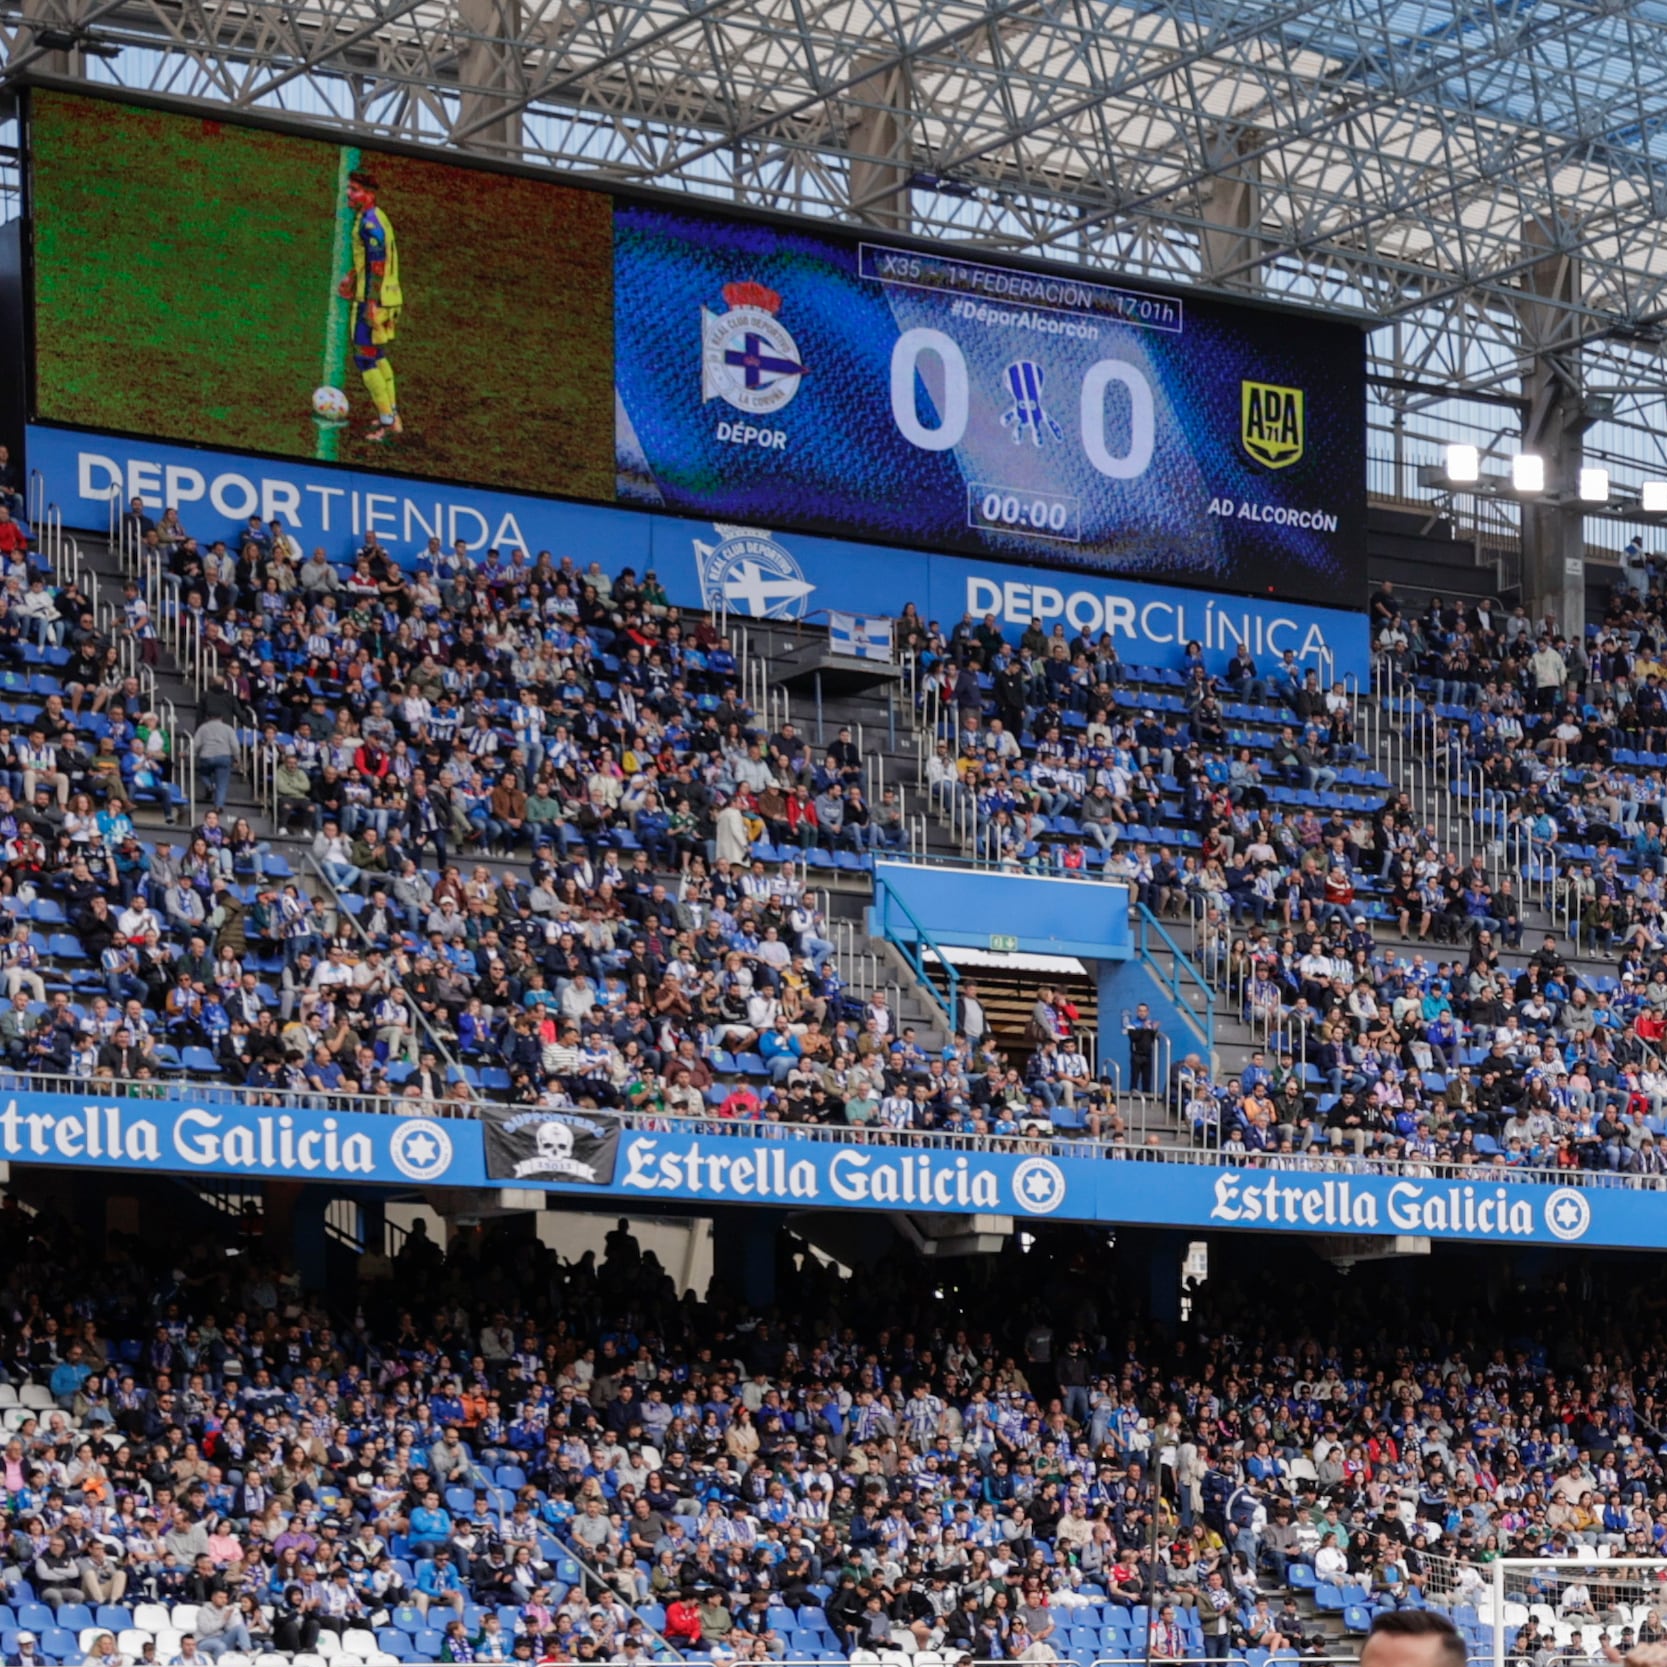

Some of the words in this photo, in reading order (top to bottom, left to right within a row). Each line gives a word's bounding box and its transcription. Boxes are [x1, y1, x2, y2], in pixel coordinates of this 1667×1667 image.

[883, 255, 921, 278] X35
[971, 270, 1092, 310] FEDERACIÓN
[951, 300, 1099, 340] #DéporAlcorcón
[890, 327, 969, 451] 0
[1080, 359, 1155, 480] 0
[716, 421, 787, 450] DÉPOR
[982, 492, 1068, 532] 00:00
[1208, 496, 1235, 519] AD
[1239, 498, 1338, 533] ALCORCÓN
[708, 557, 726, 581] REAL
[724, 542, 745, 560] CLUB
[746, 541, 793, 575] DEPORTIVO
[172, 1107, 376, 1173] Galicia
[622, 1137, 819, 1199] Estrella
[829, 1148, 1000, 1208] Galicia
[1210, 1172, 1379, 1229] Estrella
[1388, 1181, 1534, 1237] Galicia
